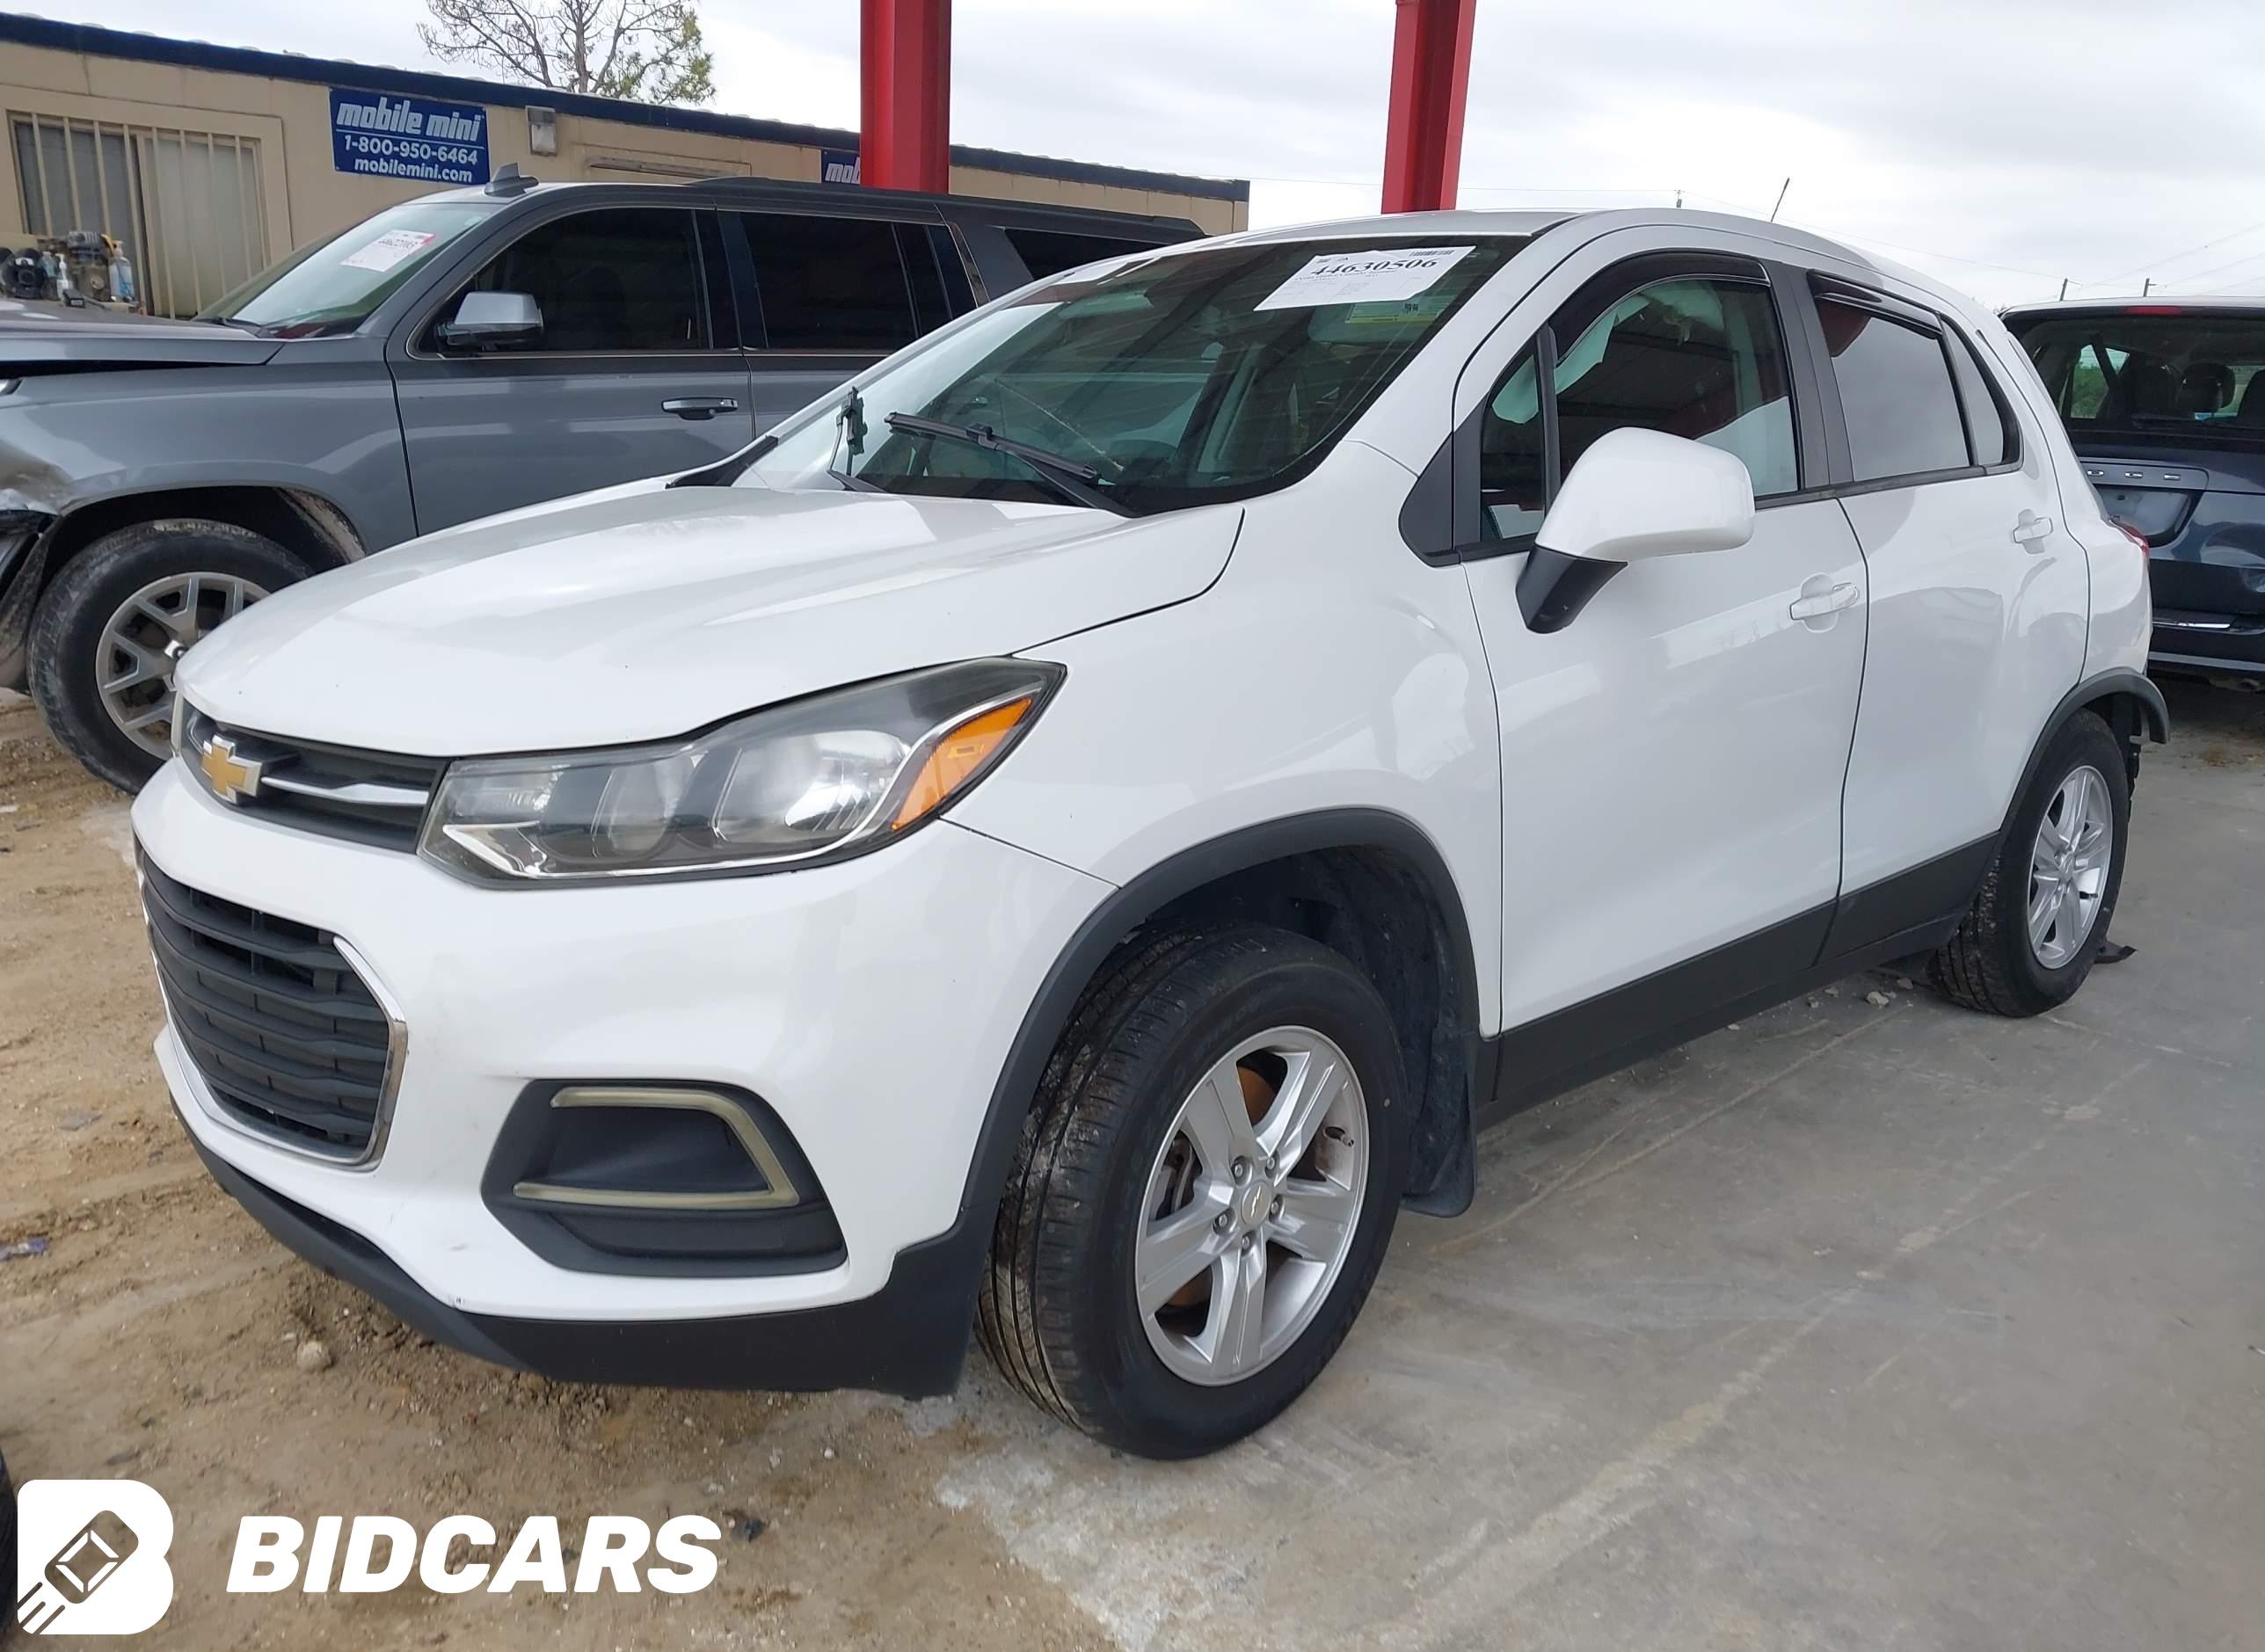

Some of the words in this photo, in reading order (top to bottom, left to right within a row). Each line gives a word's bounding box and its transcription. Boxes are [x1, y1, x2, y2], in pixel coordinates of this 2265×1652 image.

[337, 97, 422, 135] mobile
[426, 112, 482, 142] mini
[345, 135, 477, 165] 1-800-950-6464
[354, 157, 472, 183] mobilemini.com
[1311, 258, 1439, 276] 44630506
